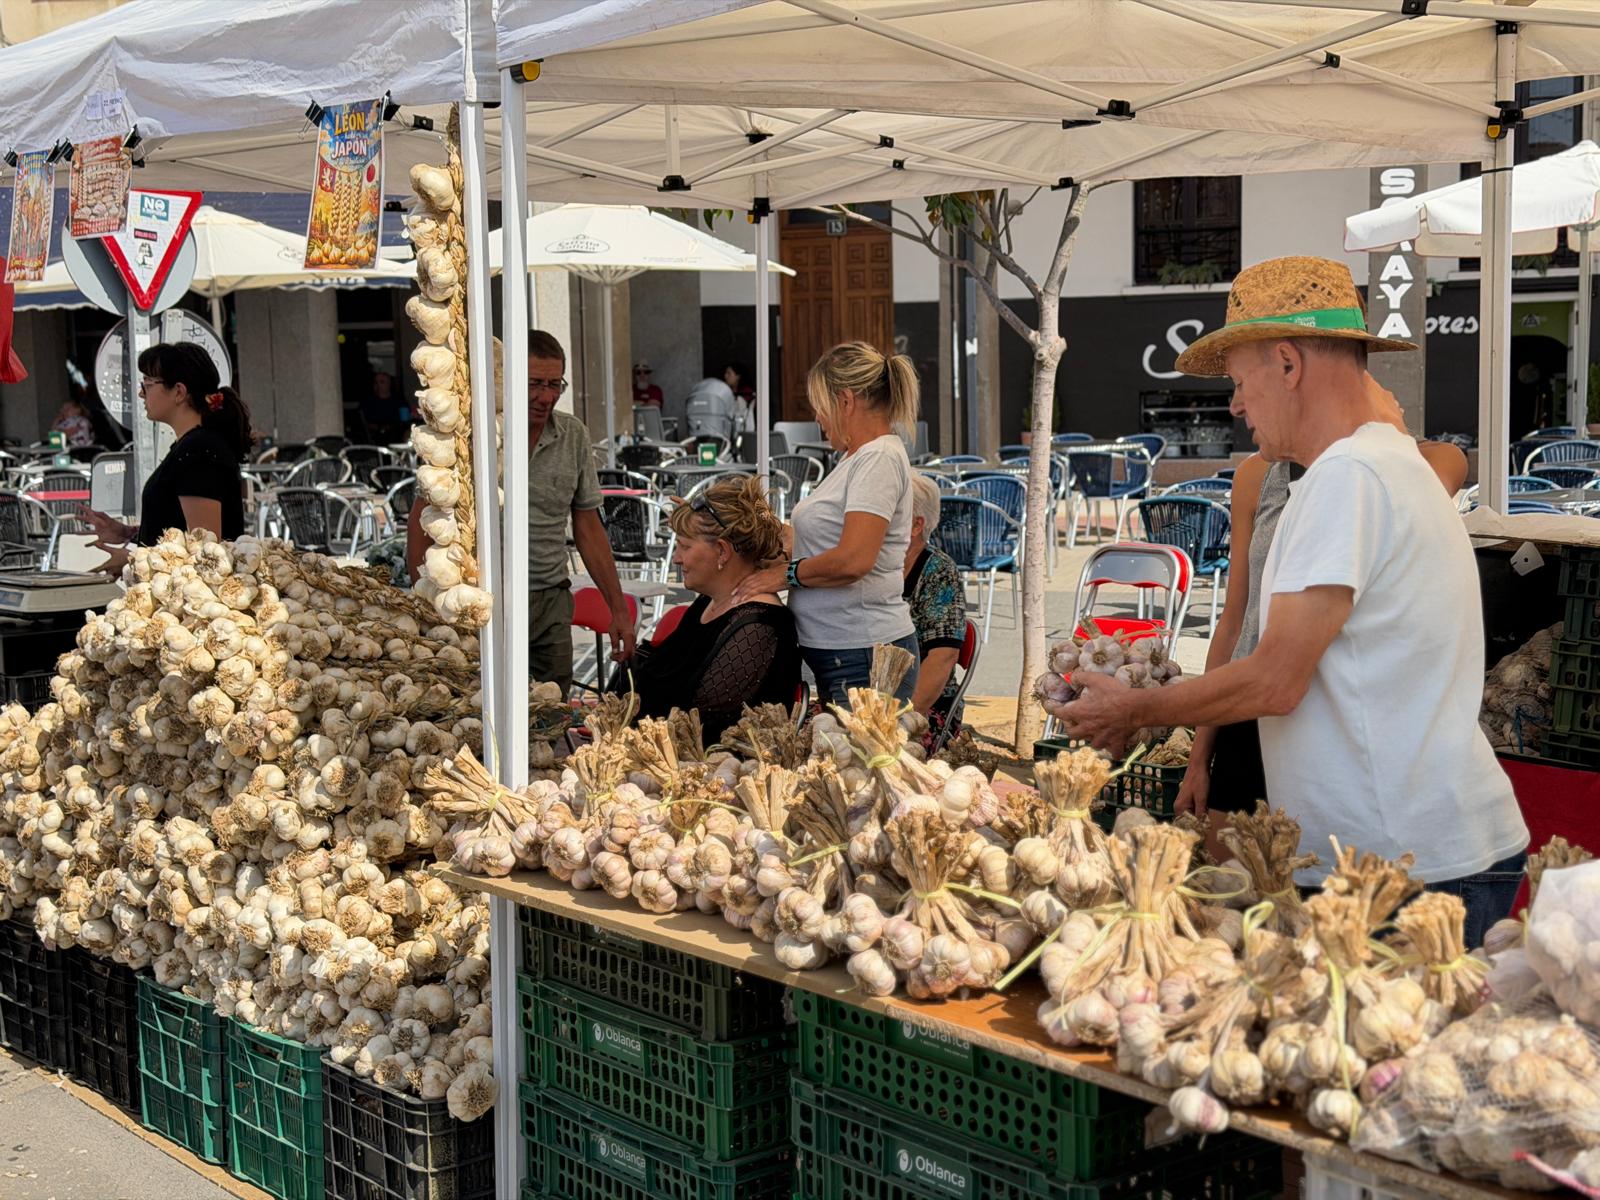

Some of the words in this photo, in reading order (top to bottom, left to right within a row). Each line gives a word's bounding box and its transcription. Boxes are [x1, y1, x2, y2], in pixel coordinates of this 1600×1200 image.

[335, 109, 366, 136] LEÓN
[331, 138, 367, 159] JAPÓN
[144, 197, 165, 212] NO
[831, 221, 844, 233] 13
[1377, 168, 1416, 338] SAYA
[605, 1026, 641, 1051] Oblanca
[610, 1143, 646, 1168] Oblanca
[915, 1156, 966, 1188] Oblanca
